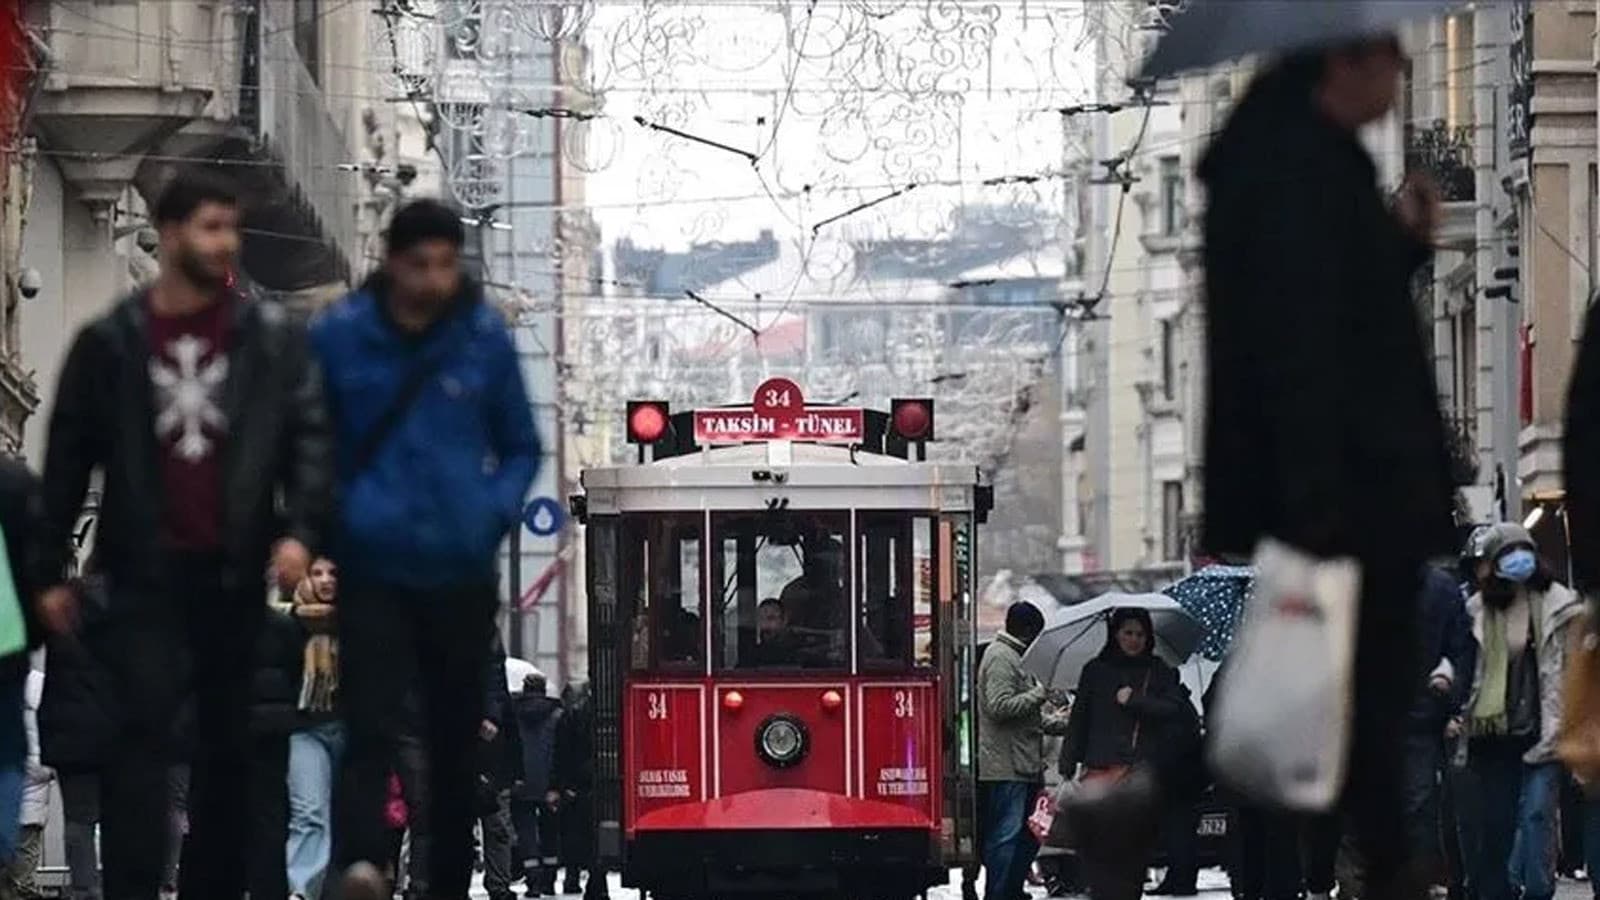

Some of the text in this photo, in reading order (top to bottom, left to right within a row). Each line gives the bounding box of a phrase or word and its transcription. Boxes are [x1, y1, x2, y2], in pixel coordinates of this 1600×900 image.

[766, 390, 791, 407] 34
[702, 414, 775, 433] TAKSİM
[795, 414, 857, 433] TÜNEL
[648, 692, 667, 720] 34
[895, 690, 913, 718] 34
